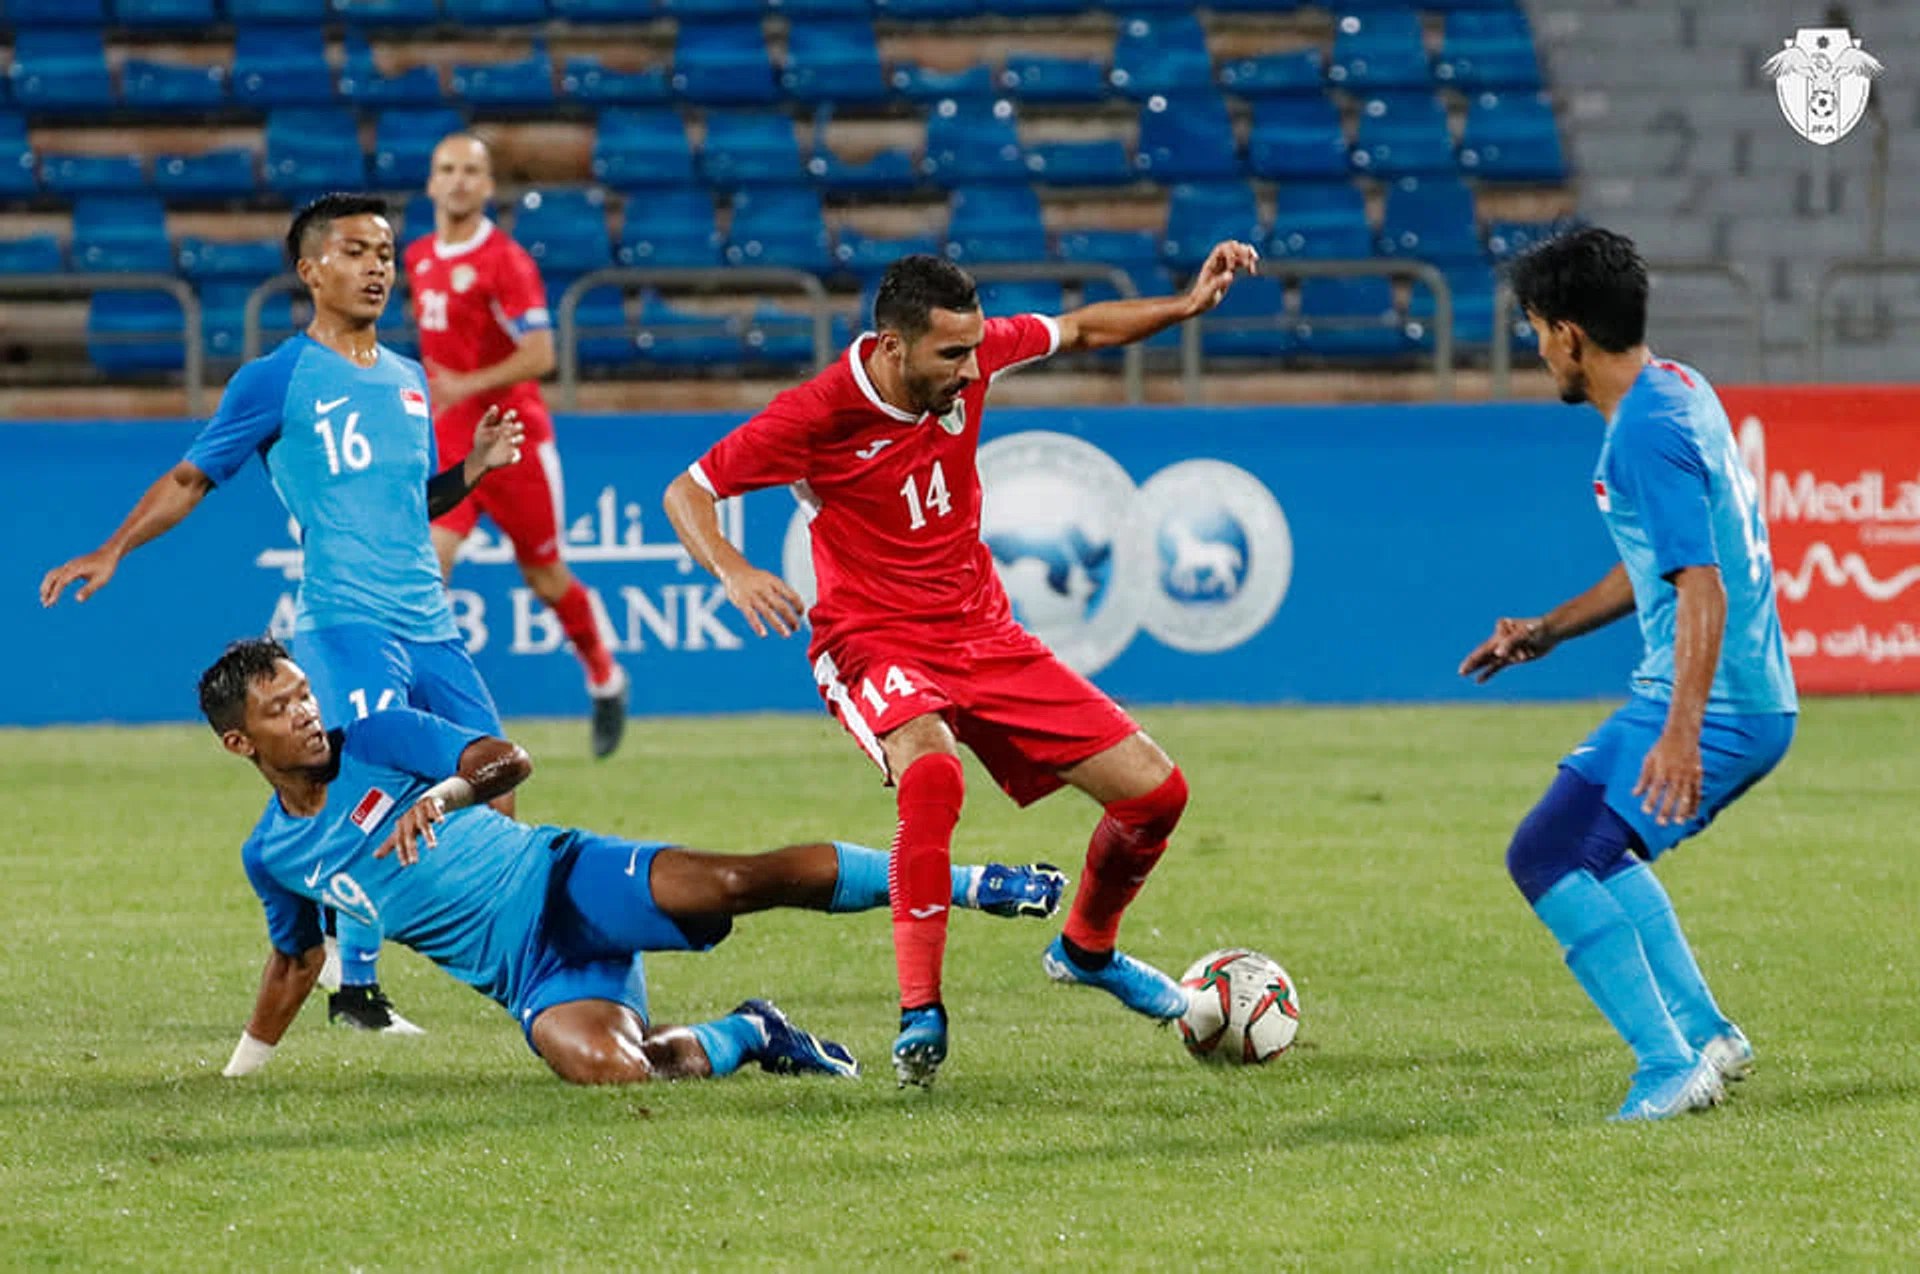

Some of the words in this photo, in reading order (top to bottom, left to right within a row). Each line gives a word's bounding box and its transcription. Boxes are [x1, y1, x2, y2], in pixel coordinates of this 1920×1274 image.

[314, 411, 373, 476] 16
[900, 459, 952, 531] 14
[1771, 470, 1920, 523] MedLa
[861, 664, 917, 718] 14
